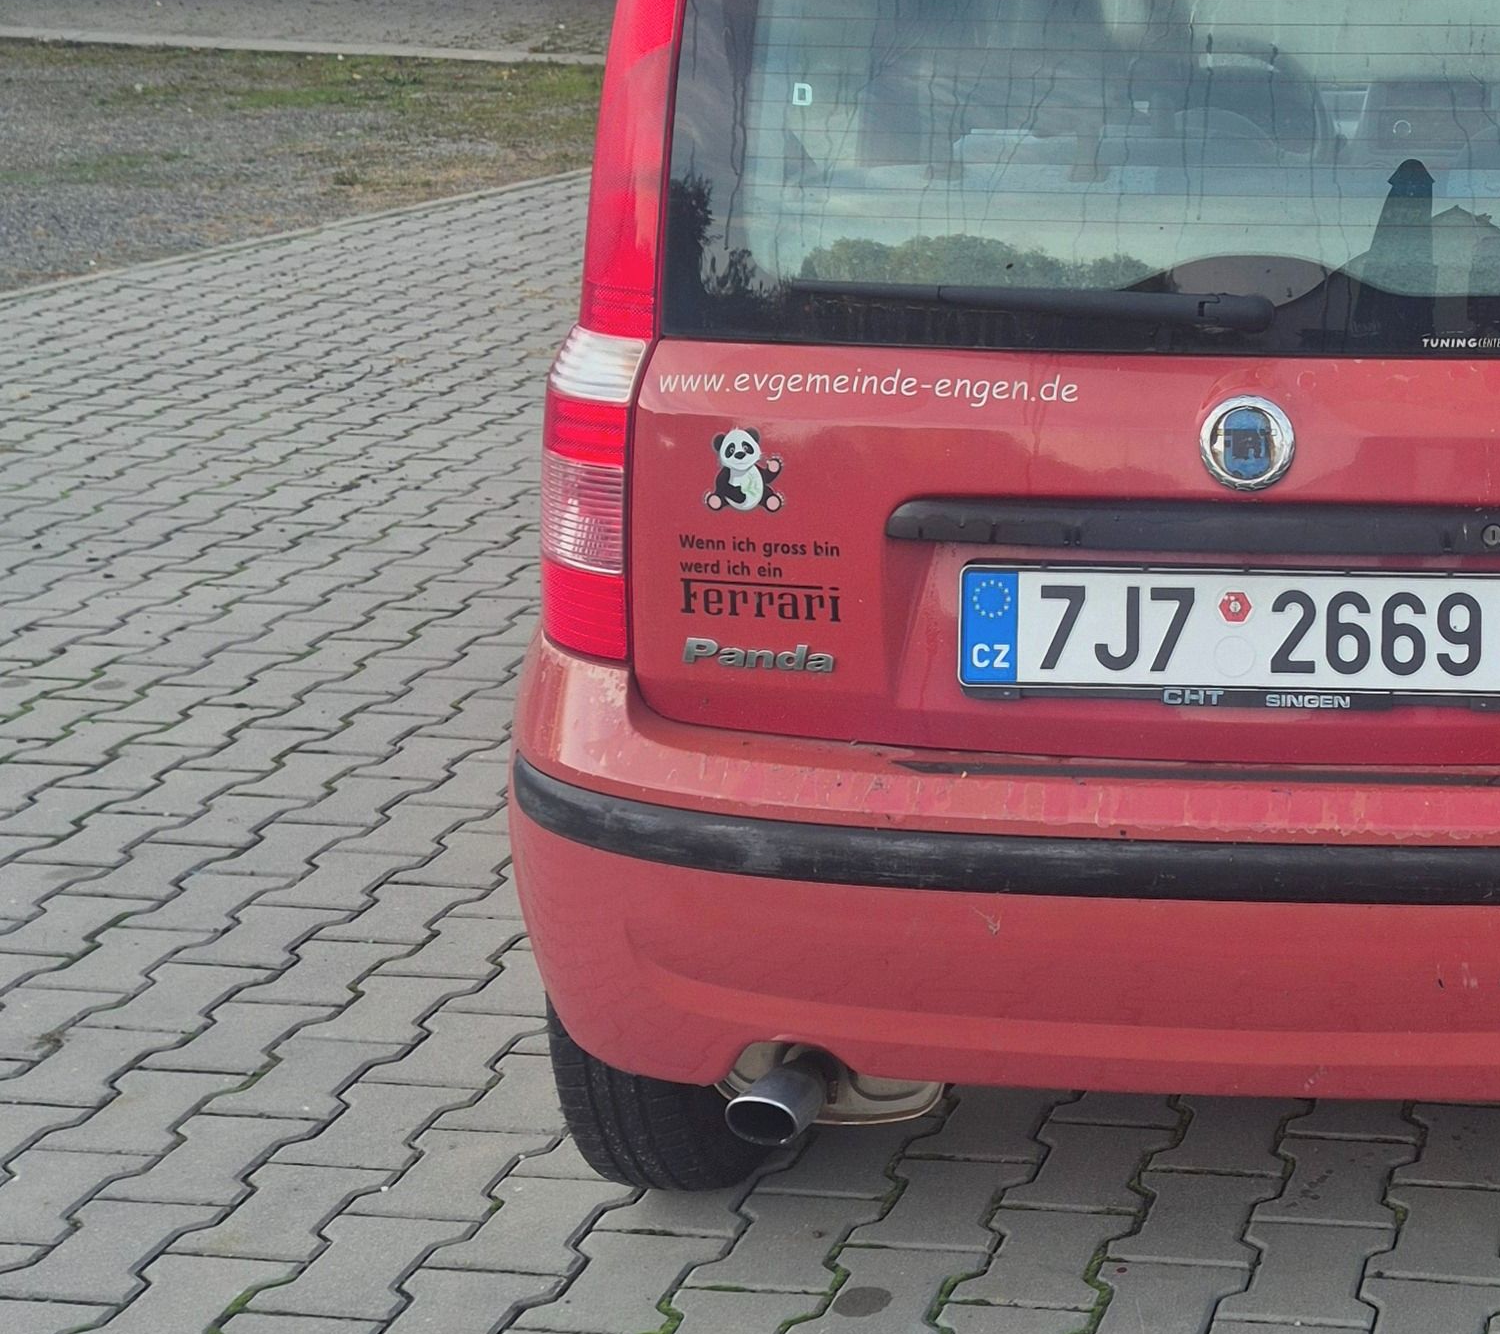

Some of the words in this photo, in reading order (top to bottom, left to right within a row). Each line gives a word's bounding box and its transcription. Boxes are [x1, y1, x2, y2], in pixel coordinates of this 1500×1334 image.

[792, 82, 812, 105] D
[658, 368, 1079, 407] www.evgemeinde-engen.de
[679, 534, 726, 551] Wenn
[732, 536, 756, 553] ich
[762, 542, 807, 557] gross
[813, 541, 840, 557] bin
[680, 560, 721, 574] werd
[727, 560, 751, 576] ich
[757, 563, 783, 578] ein
[680, 578, 842, 623] Ferrari
[1039, 585, 1196, 672] 7J7
[1269, 590, 1483, 677] 2669
[682, 637, 836, 672] Panda
[971, 643, 1010, 669] CZ
[1162, 688, 1225, 706] CHT
[1265, 693, 1351, 709] SINGEN
